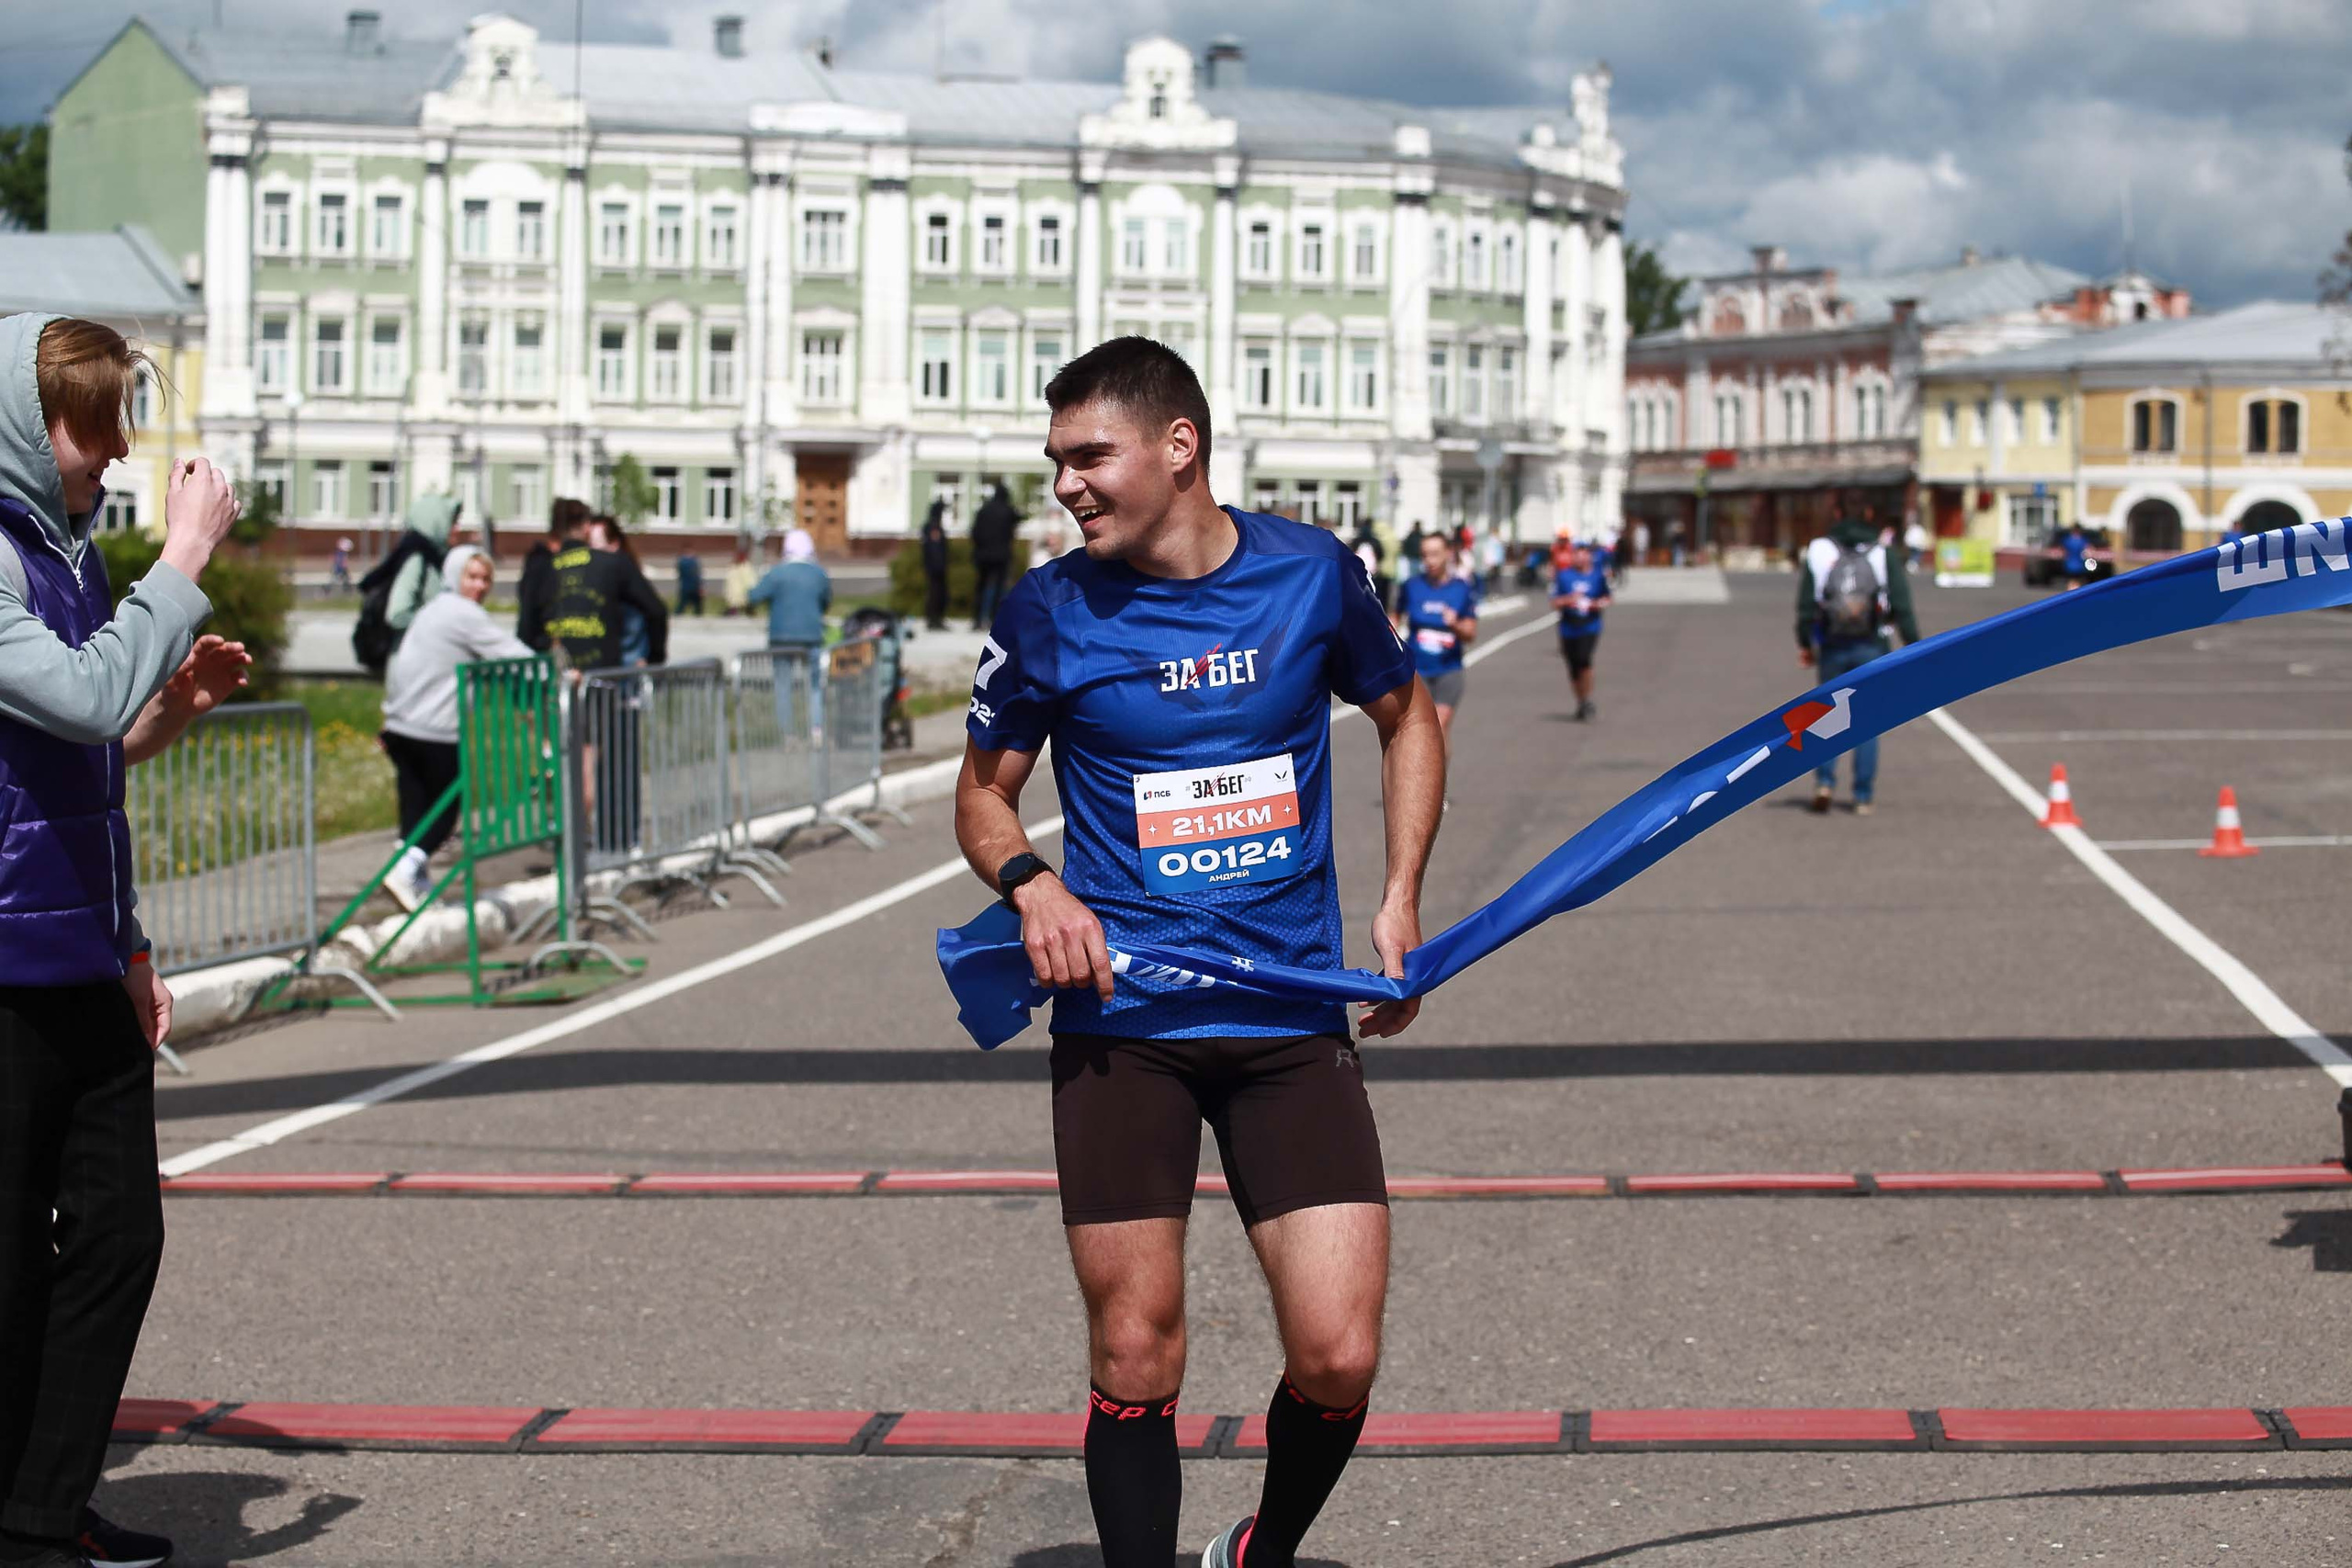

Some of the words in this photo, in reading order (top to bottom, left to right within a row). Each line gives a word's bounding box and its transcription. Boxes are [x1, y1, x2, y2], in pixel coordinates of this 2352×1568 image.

[1154, 790, 1171, 798] ПСБ
[1158, 836, 1292, 877] 00124
[1208, 869, 1250, 883] АНДРЕЙ
